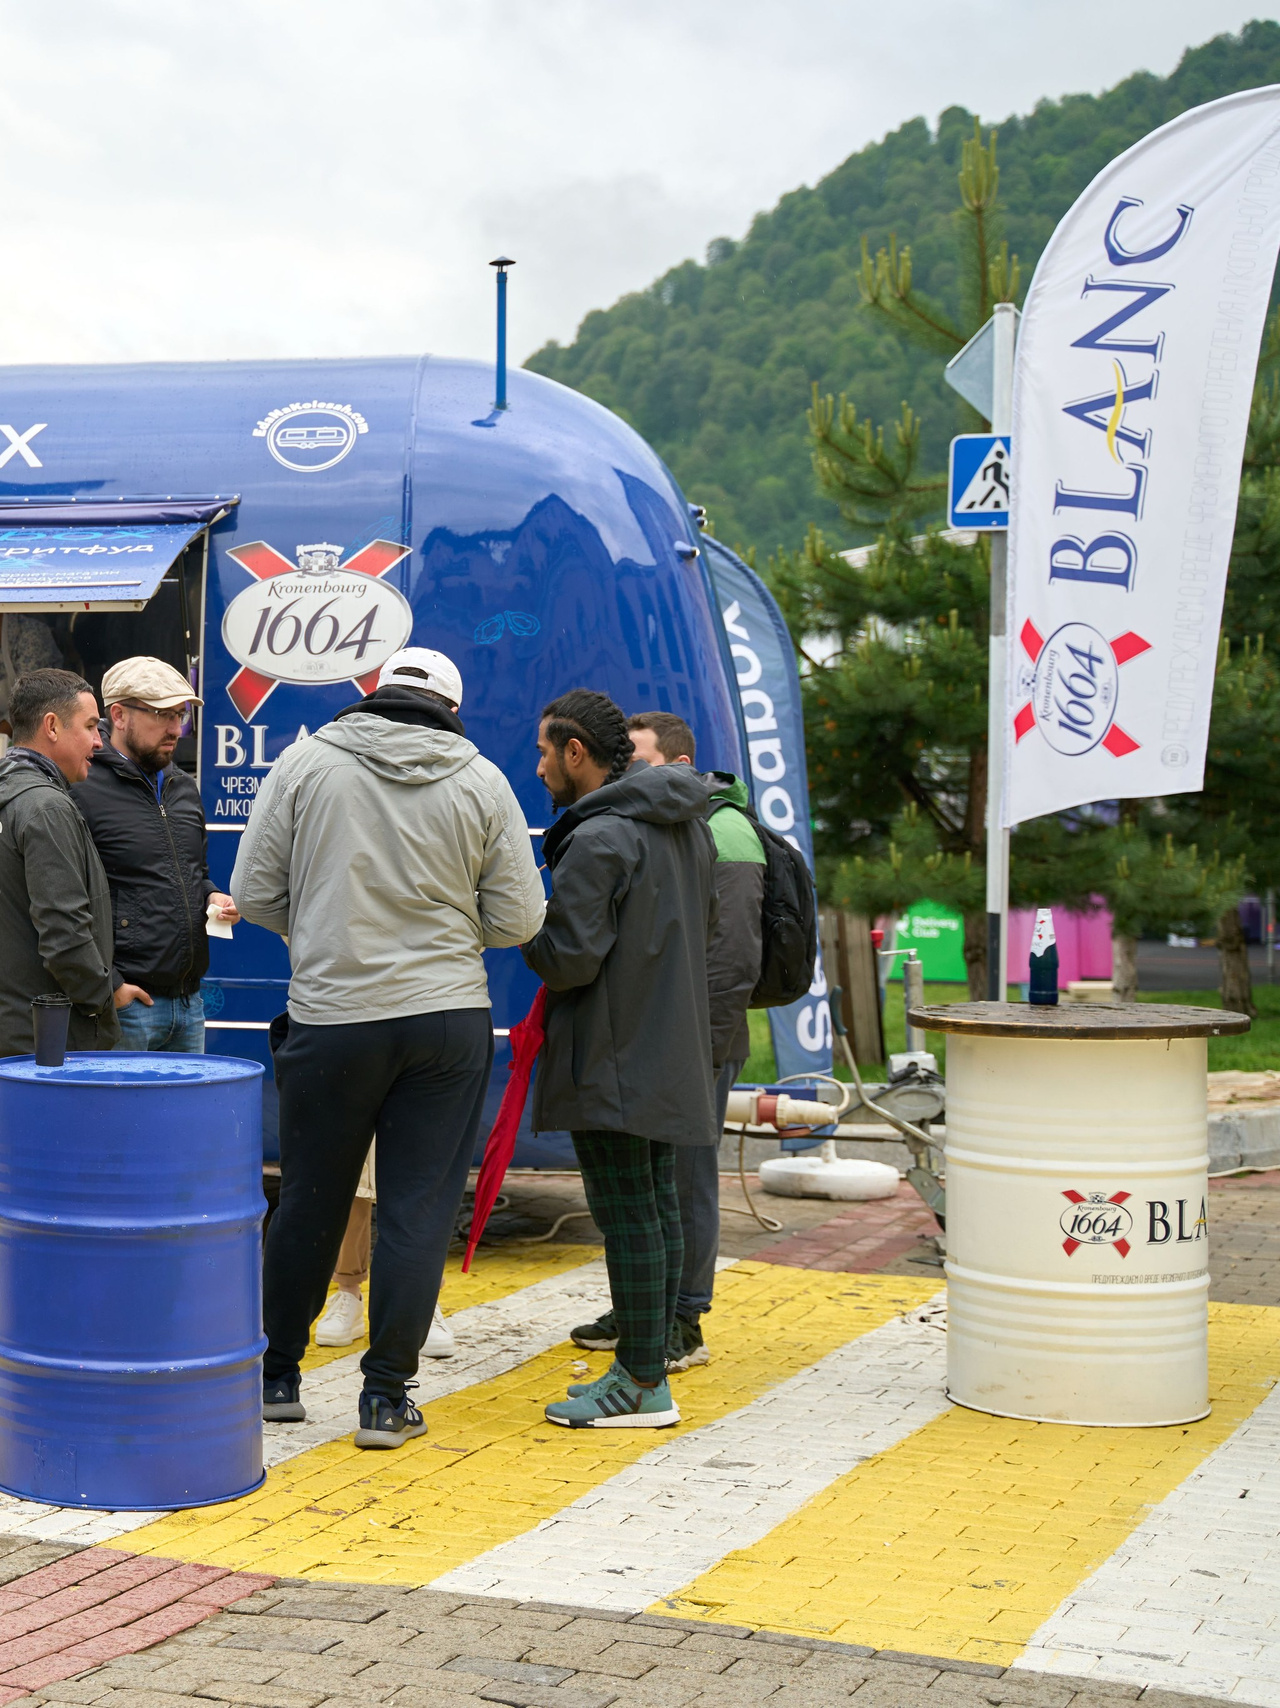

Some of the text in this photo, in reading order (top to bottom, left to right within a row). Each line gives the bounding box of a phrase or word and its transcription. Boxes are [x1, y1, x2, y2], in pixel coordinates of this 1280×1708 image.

[1048, 195, 1195, 593] BLANC
[267, 581, 368, 599] Kronenbourg
[248, 596, 383, 660] 1664
[1039, 649, 1061, 722] Kronenbourg
[1053, 643, 1104, 740] 1664
[1070, 1211, 1124, 1237] 1664
